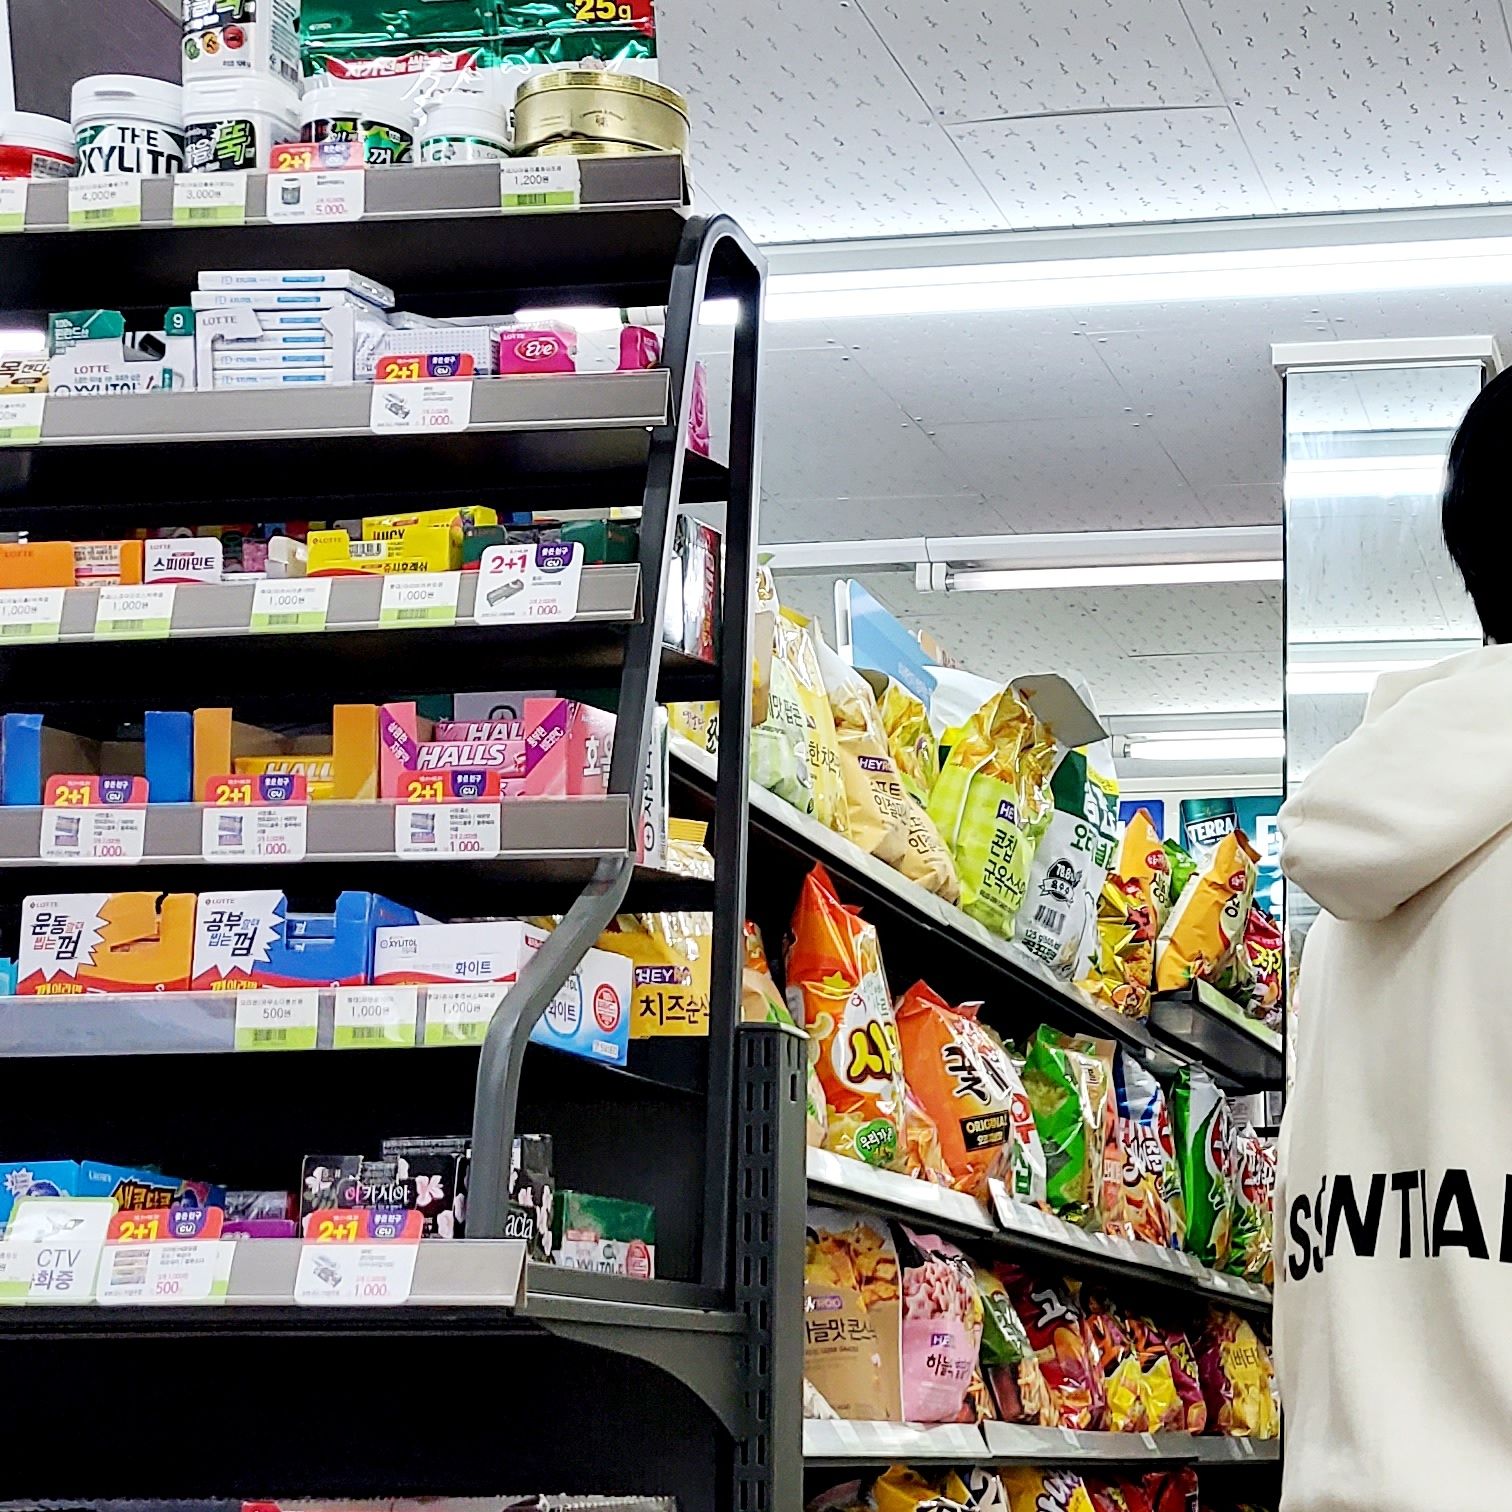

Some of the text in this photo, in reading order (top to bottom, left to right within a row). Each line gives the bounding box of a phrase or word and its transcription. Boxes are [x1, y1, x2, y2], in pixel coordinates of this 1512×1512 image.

[118, 127, 158, 147] THE
[278, 153, 310, 170] 2+1
[172, 314, 183, 328] 9
[202, 316, 237, 326] LOTTE
[526, 340, 553, 357] Eve
[75, 365, 109, 374] LOTTE
[385, 363, 419, 382] 2+1
[153, 556, 214, 571] 스피아민트
[489, 555, 526, 574] 2+1
[417, 744, 504, 768] HALLS
[55, 785, 90, 806] 2+1
[216, 785, 250, 804] 2+1
[408, 781, 442, 802] 2+1
[1187, 815, 1235, 840] TERRA
[389, 940, 417, 948] XYLITOL
[456, 962, 492, 975] 화이트
[263, 1008, 290, 1018] 500원
[352, 1004, 389, 1017] 1,000원
[442, 1003, 480, 1013] 1,000원
[346, 1185, 409, 1202] 아카시아
[120, 1222, 157, 1241] 2+1
[180, 1224, 194, 1233] CU
[318, 1221, 358, 1241] 2+1
[378, 1227, 392, 1237] CU
